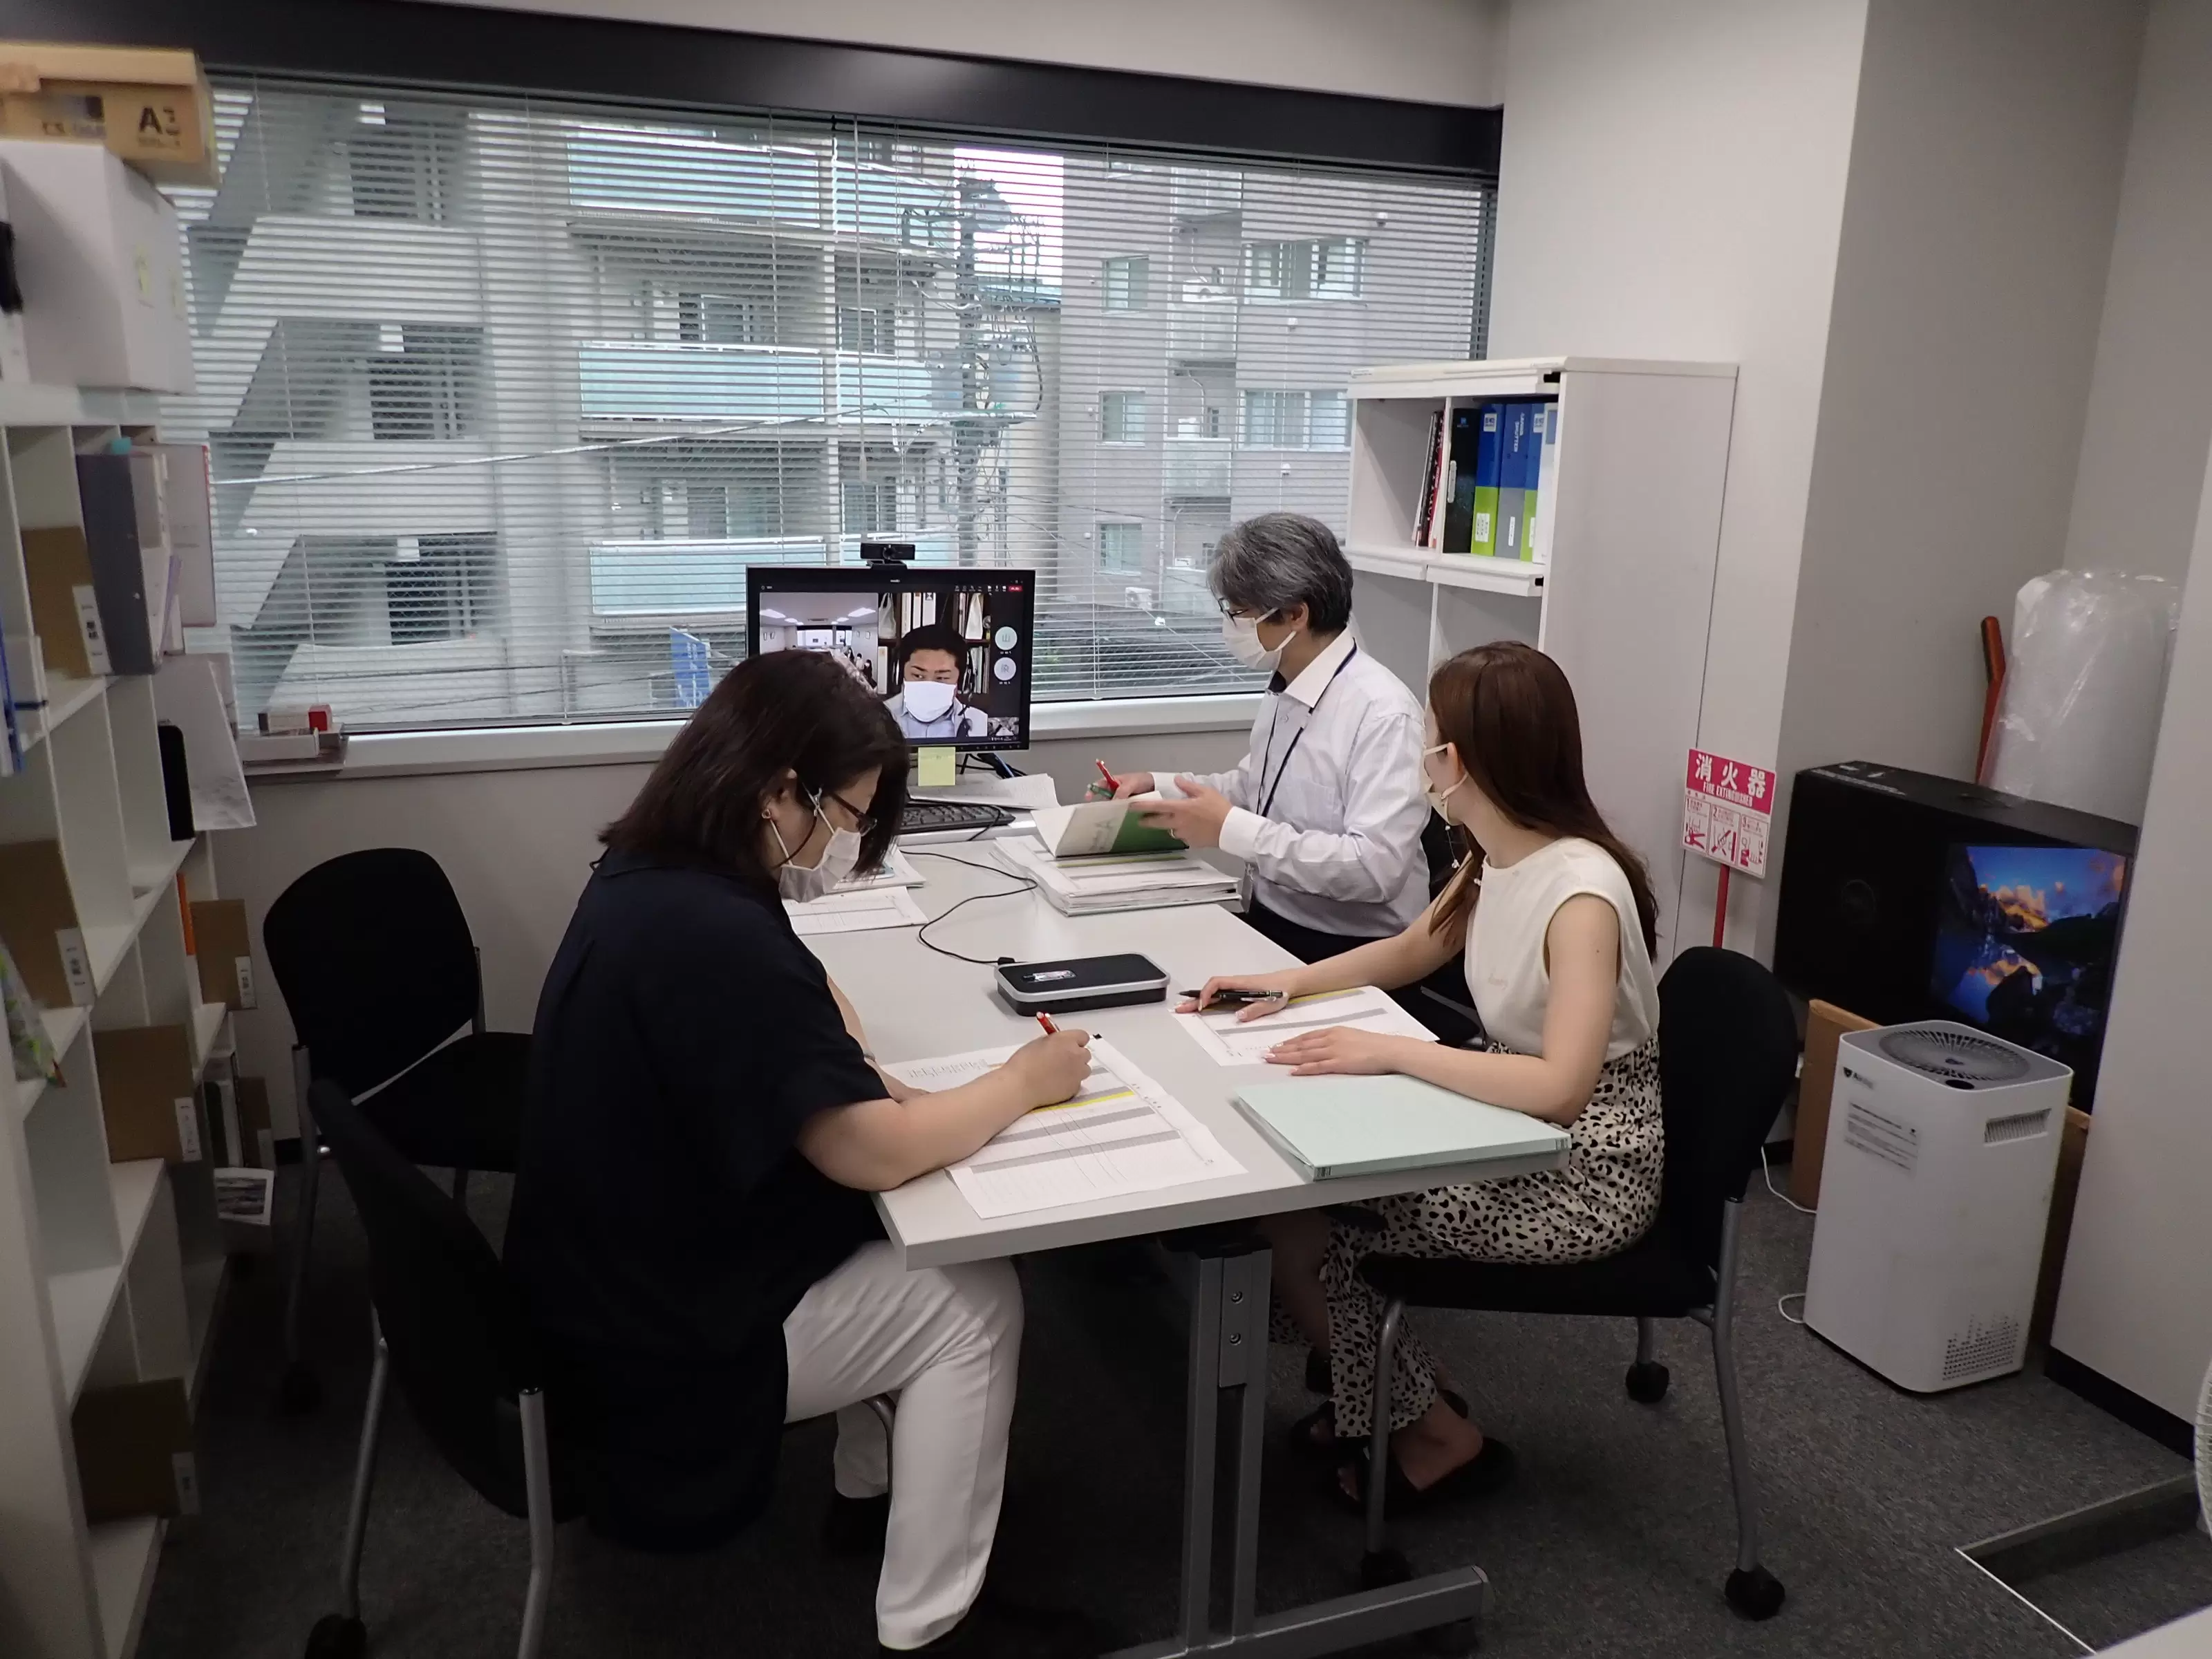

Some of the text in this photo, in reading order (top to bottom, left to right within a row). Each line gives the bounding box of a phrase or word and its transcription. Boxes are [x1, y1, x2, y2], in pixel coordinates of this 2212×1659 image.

[1695, 753, 1766, 799] 消火器
[1703, 780, 1715, 795] FIRE
